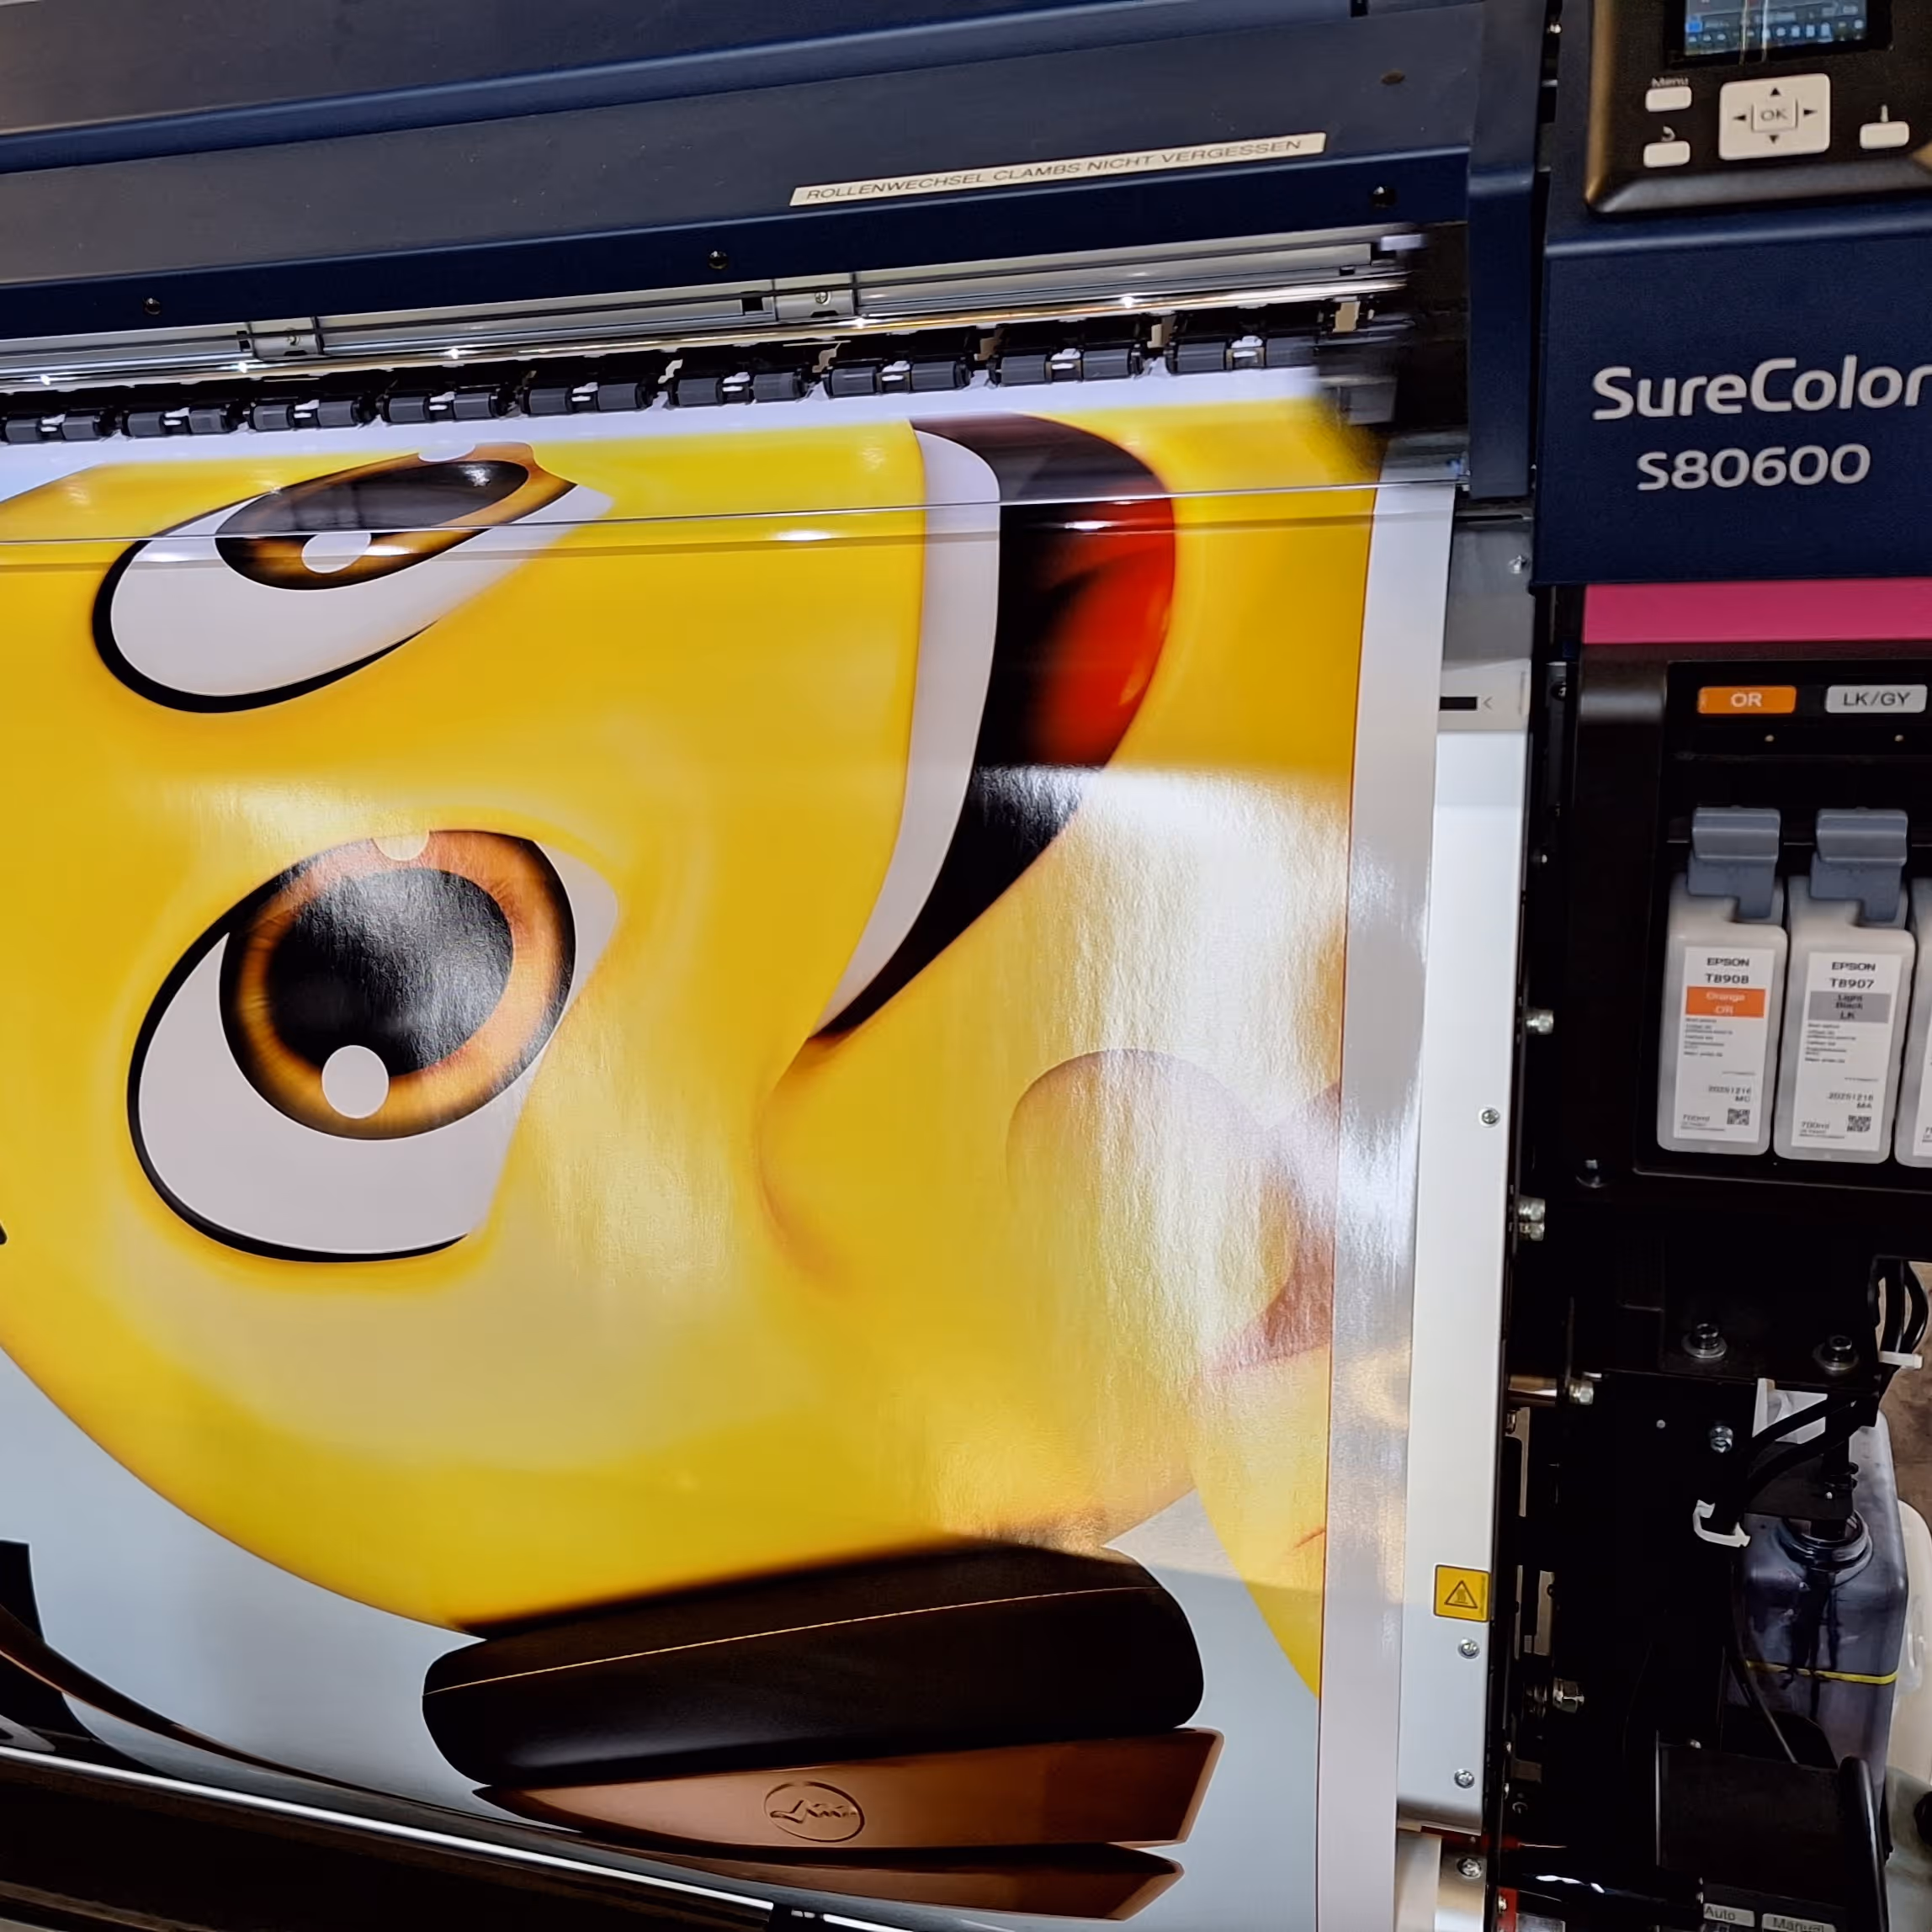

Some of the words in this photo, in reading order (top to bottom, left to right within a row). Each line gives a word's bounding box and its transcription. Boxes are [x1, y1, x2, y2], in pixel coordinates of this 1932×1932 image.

[1652, 77, 1689, 88] Menu
[1760, 109, 1787, 121] OK
[806, 172, 985, 200] ROLLENWECHSEL
[993, 161, 1080, 181] CLAMBS
[1085, 154, 1154, 172] NICHT
[1160, 140, 1302, 163] VERGESSEN
[1592, 354, 1932, 420] SureColor
[1637, 443, 1871, 491] S80600
[1730, 692, 1762, 707] OR
[1843, 691, 1911, 706] LK/GY
[1706, 958, 1749, 966] EPSON
[1831, 962, 1876, 971] EPSON
[1706, 974, 1749, 984] T8908
[1829, 978, 1875, 989] T8907
[1706, 991, 1745, 1002] Orange
[1716, 1006, 1733, 1014] OR
[1704, 1906, 1737, 1921] Auto
[1773, 1917, 1824, 1932] Manual
